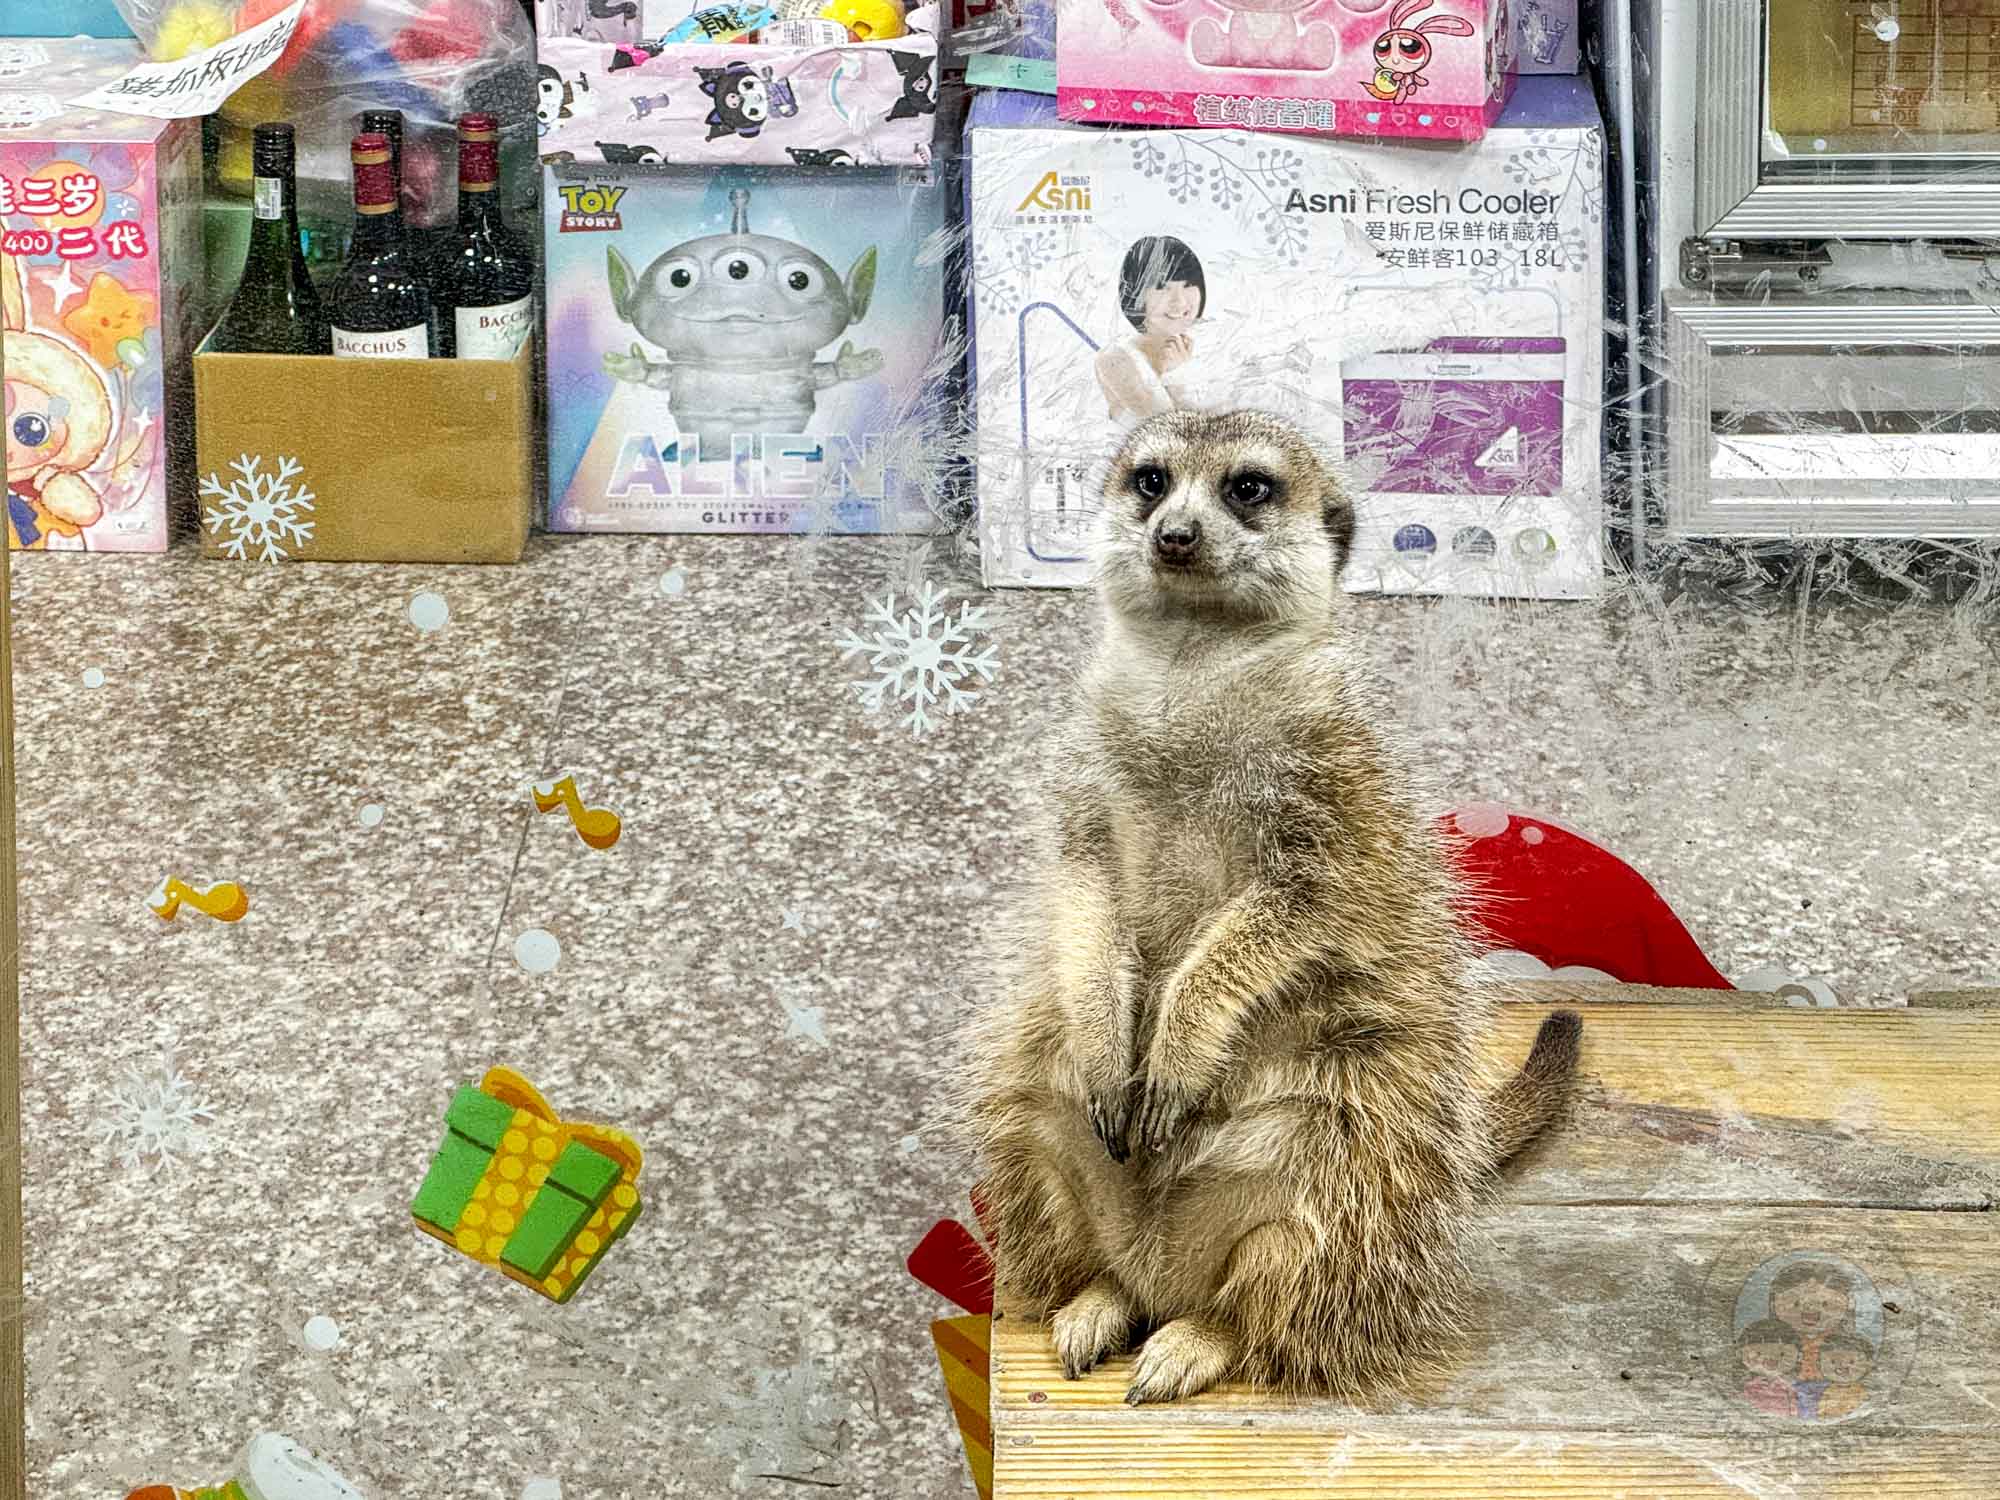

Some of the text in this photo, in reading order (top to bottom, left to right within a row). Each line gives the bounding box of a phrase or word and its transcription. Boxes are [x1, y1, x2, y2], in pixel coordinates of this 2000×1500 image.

[1194, 95, 1335, 129] 植绒储蓄罐
[559, 185, 628, 214] TOY
[1016, 171, 1091, 211] Asni
[1284, 188, 1561, 214] Asni Fresh Cooler
[566, 216, 616, 227] STORY
[1365, 220, 1560, 241] 爱斯尼保鲜储藏箱
[1519, 248, 1563, 267] 18L
[337, 337, 406, 354] BACCHUS
[606, 433, 886, 498] ALIEN
